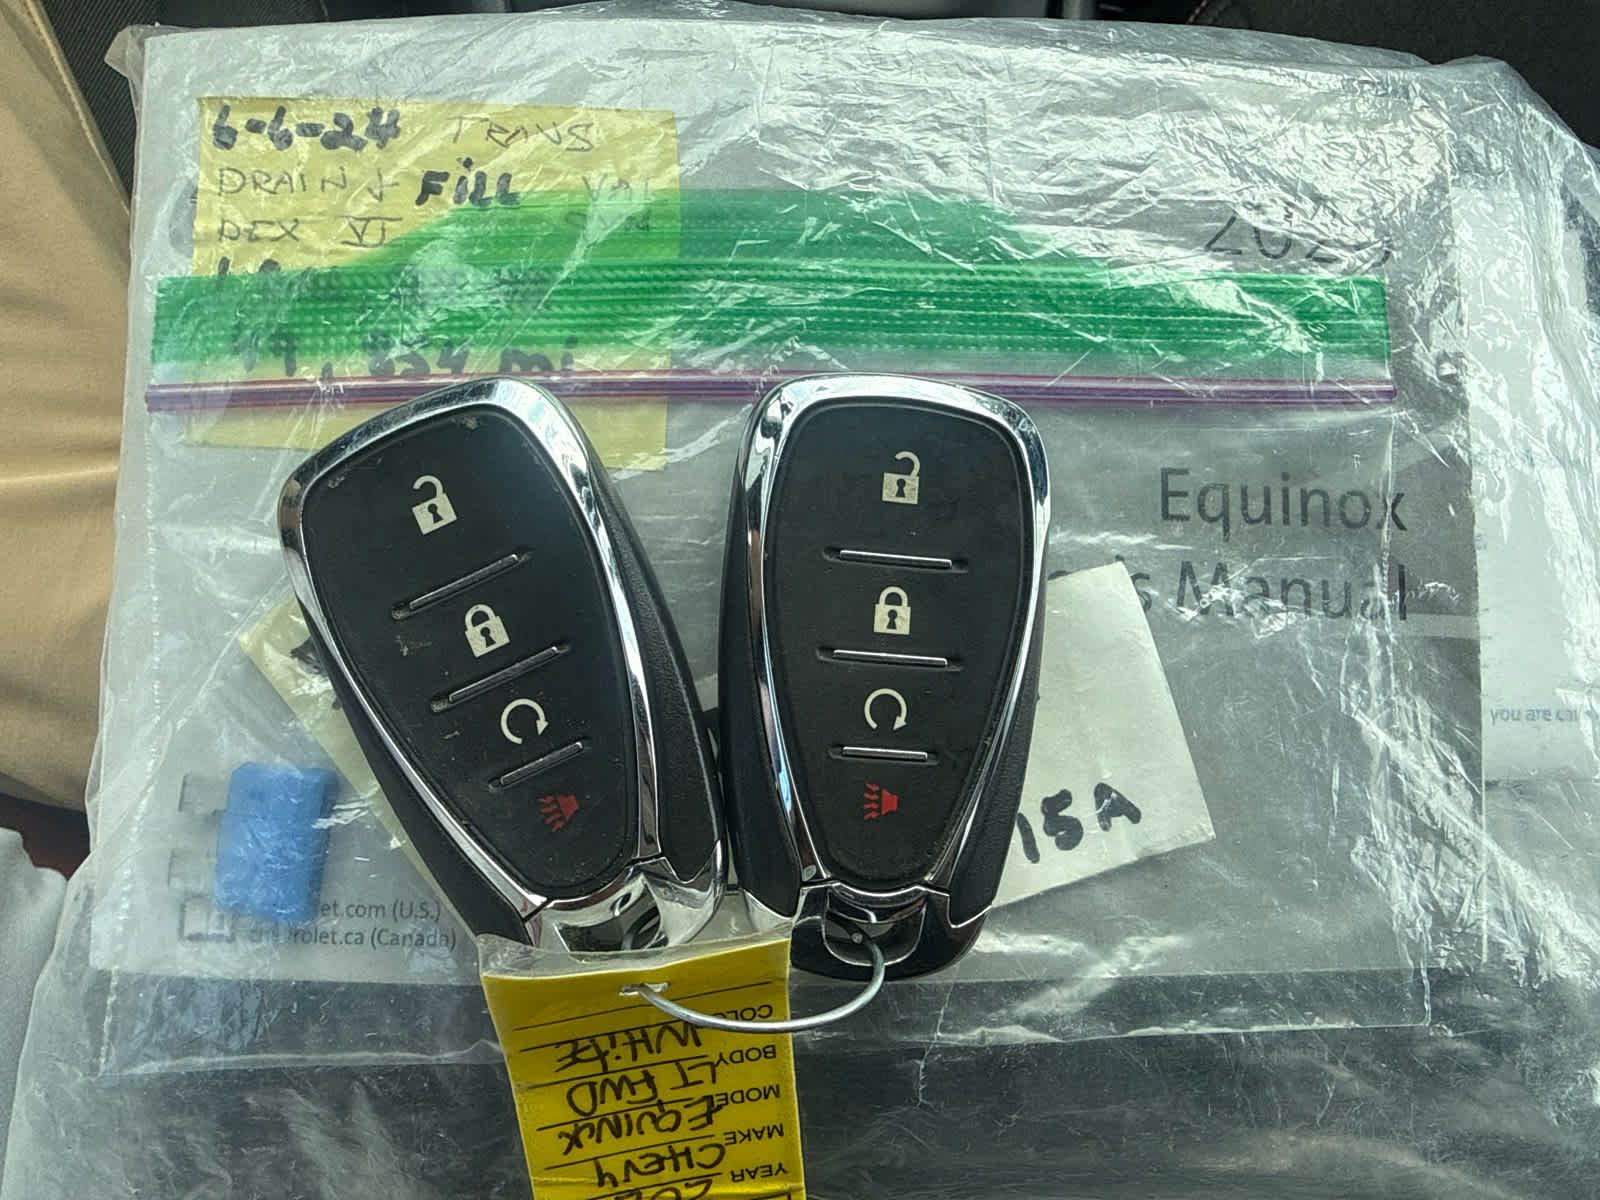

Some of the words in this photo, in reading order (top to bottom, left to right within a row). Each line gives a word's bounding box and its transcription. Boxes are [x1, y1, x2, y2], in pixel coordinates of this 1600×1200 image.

[212, 104, 401, 152] 6-6-24
[448, 115, 595, 152] TRANS
[217, 166, 348, 196] DRAIN
[218, 217, 300, 242] DEX
[1160, 467, 1407, 542] Equinox
[1176, 560, 1407, 620] Manual
[1490, 708, 1521, 726] you
[1526, 708, 1552, 722] are
[393, 901, 441, 923] (U.S.)
[371, 926, 457, 950] (Canada)
[714, 1043, 777, 1067] BODY
[669, 1060, 718, 1091] LT
[566, 1069, 659, 1117] FWD
[723, 1122, 785, 1146] MAKE
[596, 1142, 726, 1188] CHEVY
[730, 1161, 789, 1183] YEAR
